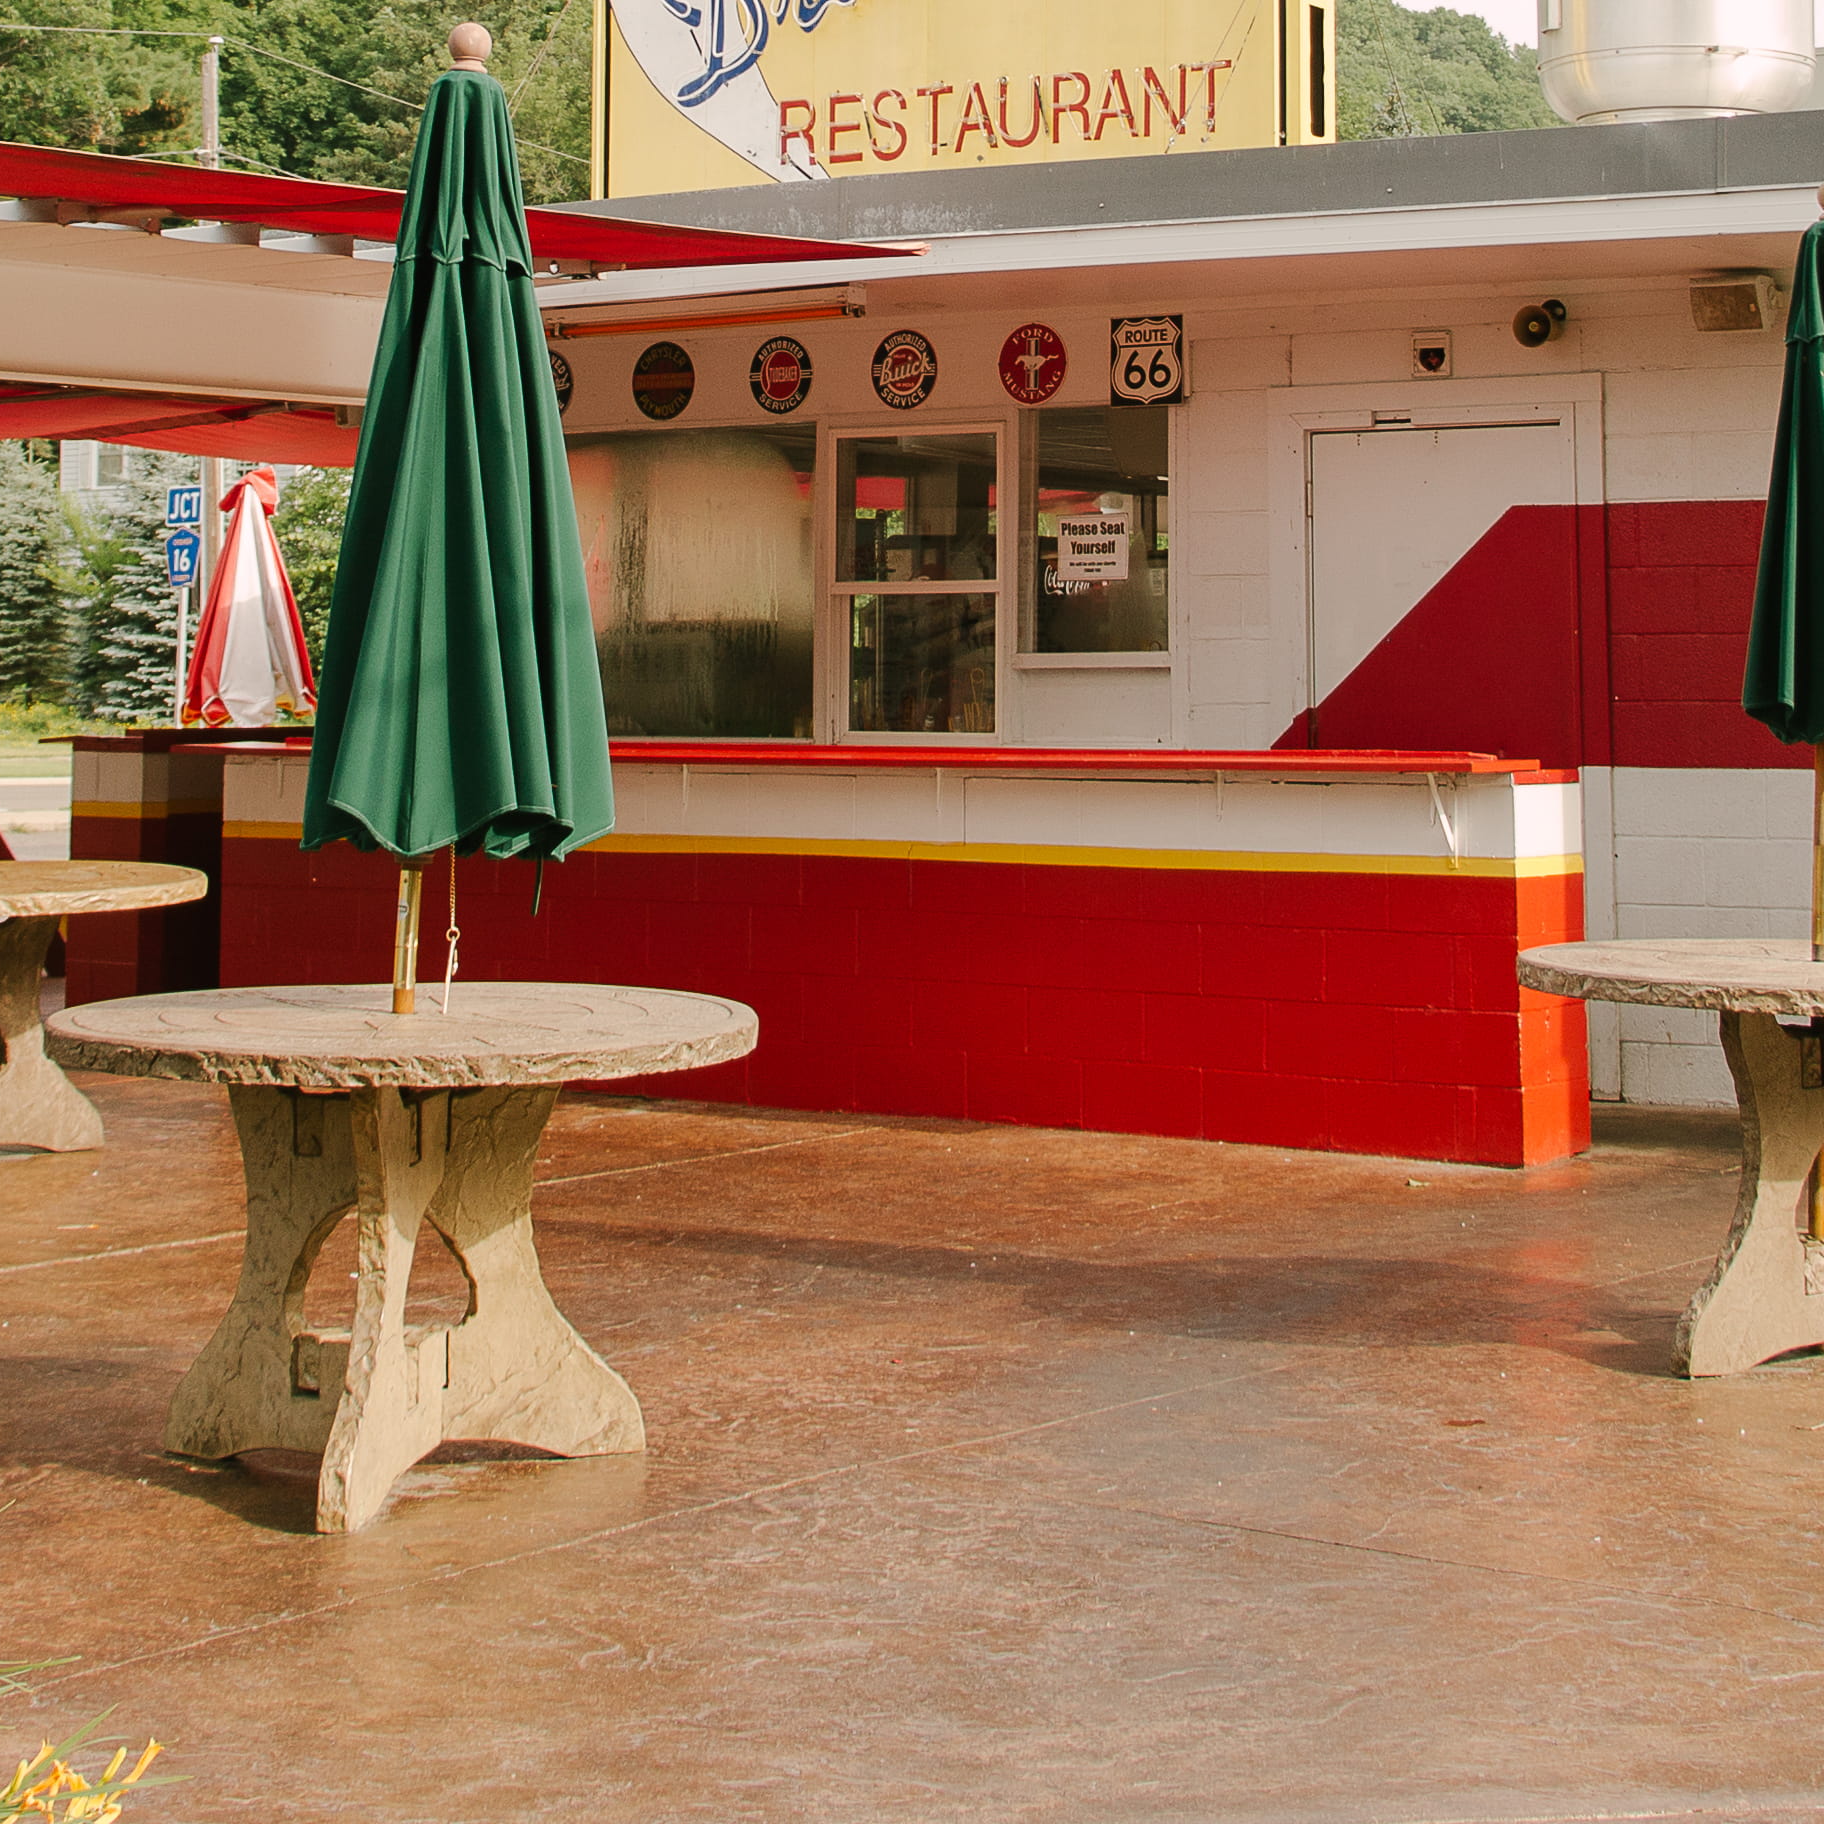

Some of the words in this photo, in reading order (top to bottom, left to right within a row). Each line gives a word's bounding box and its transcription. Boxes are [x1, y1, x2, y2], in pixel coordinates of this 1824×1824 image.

[779, 58, 1232, 167] RESTAURANT
[884, 332, 927, 353] AUTHORIZED
[1012, 327, 1054, 345] FORD
[1124, 328, 1168, 344] ROUTE
[757, 340, 804, 363] AUTHORIZED
[879, 351, 933, 387] Buick
[1124, 348, 1172, 390] 66
[880, 386, 926, 407] SERVICE
[1002, 370, 1062, 401] MUSTANG
[638, 393, 687, 417] PLYMOUTH
[758, 392, 803, 412] SERVICE
[169, 491, 200, 520] JCT
[1061, 522, 1098, 537] Please
[1099, 521, 1125, 536] Seat
[1070, 539, 1116, 555] Yourself
[173, 548, 191, 573] 16
